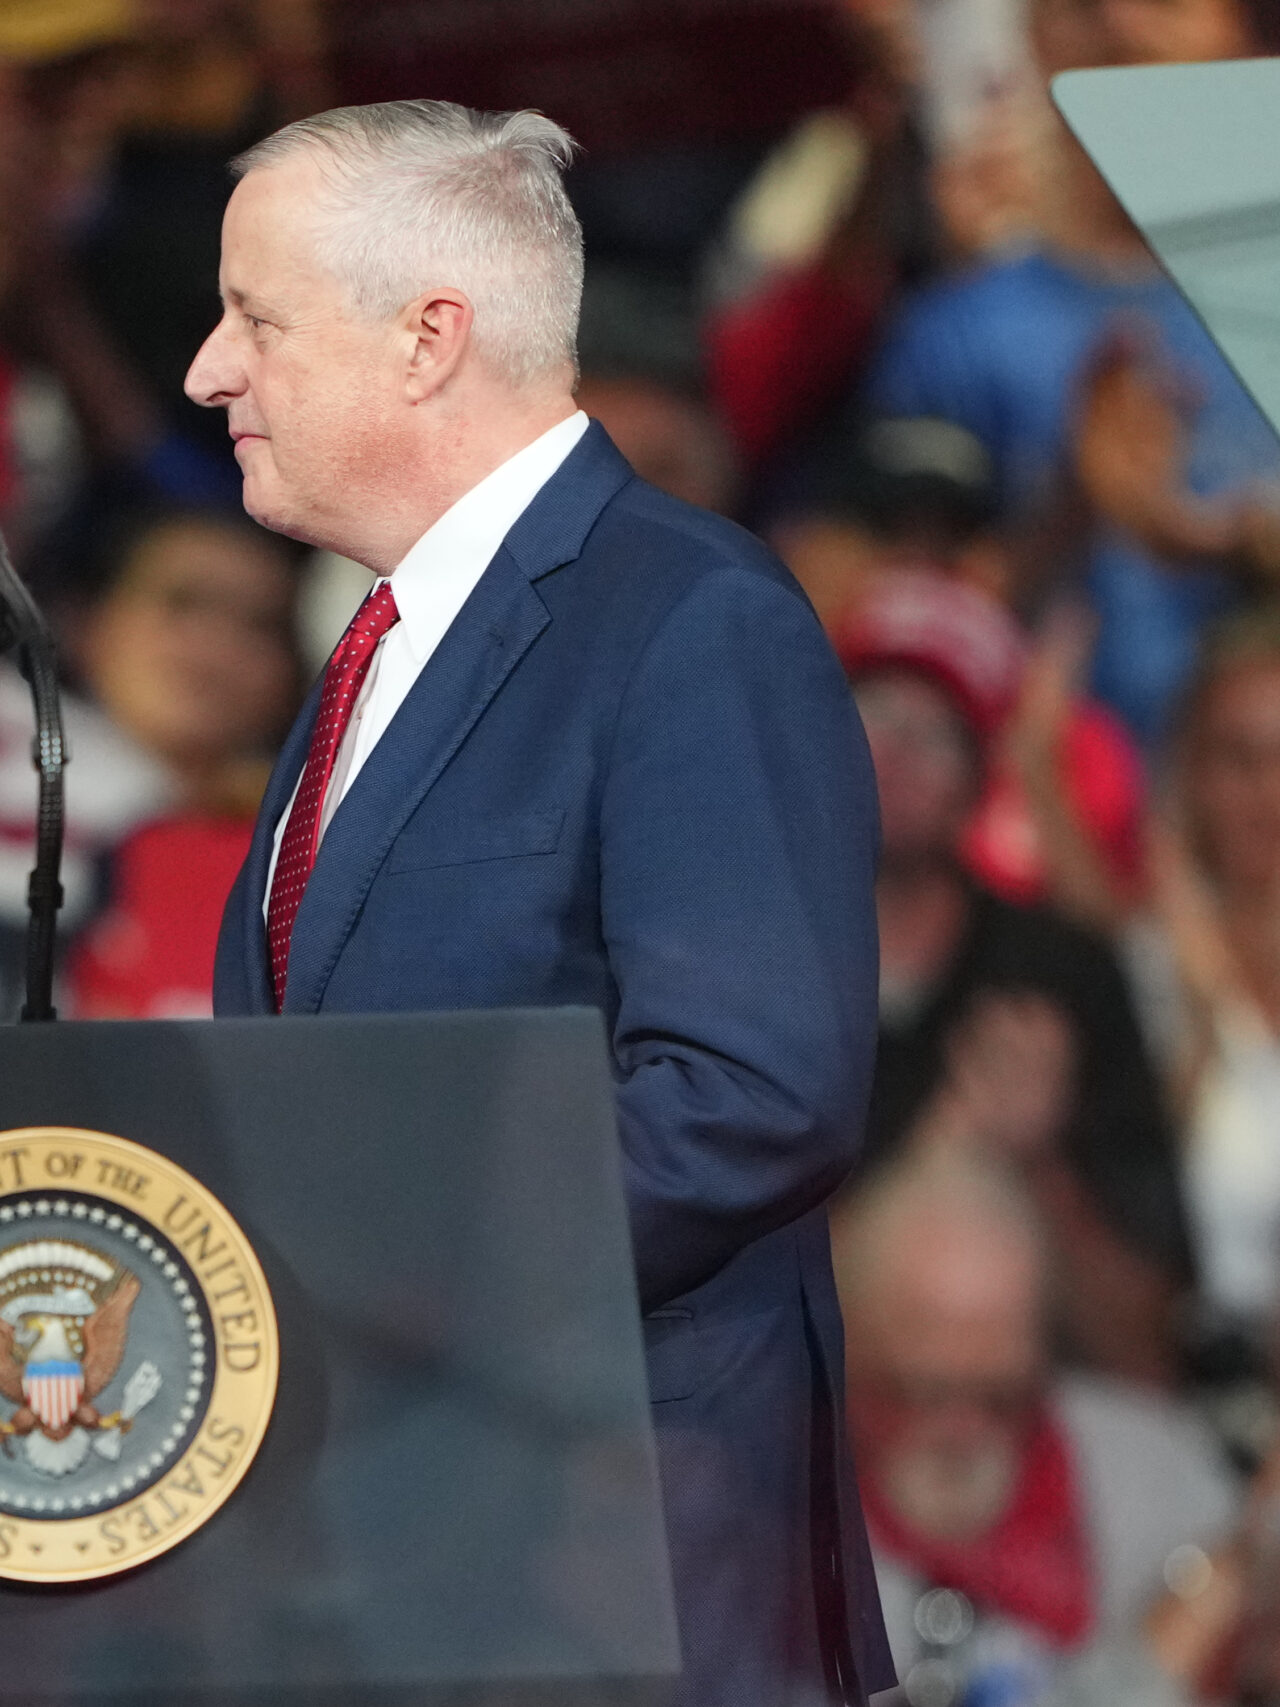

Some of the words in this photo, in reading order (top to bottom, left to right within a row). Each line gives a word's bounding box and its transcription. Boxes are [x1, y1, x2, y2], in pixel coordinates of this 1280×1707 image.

[45, 1151, 85, 1177] OF
[97, 1160, 153, 1197] THE
[162, 1196, 262, 1373] UNITED
[99, 1416, 246, 1556] STATES
